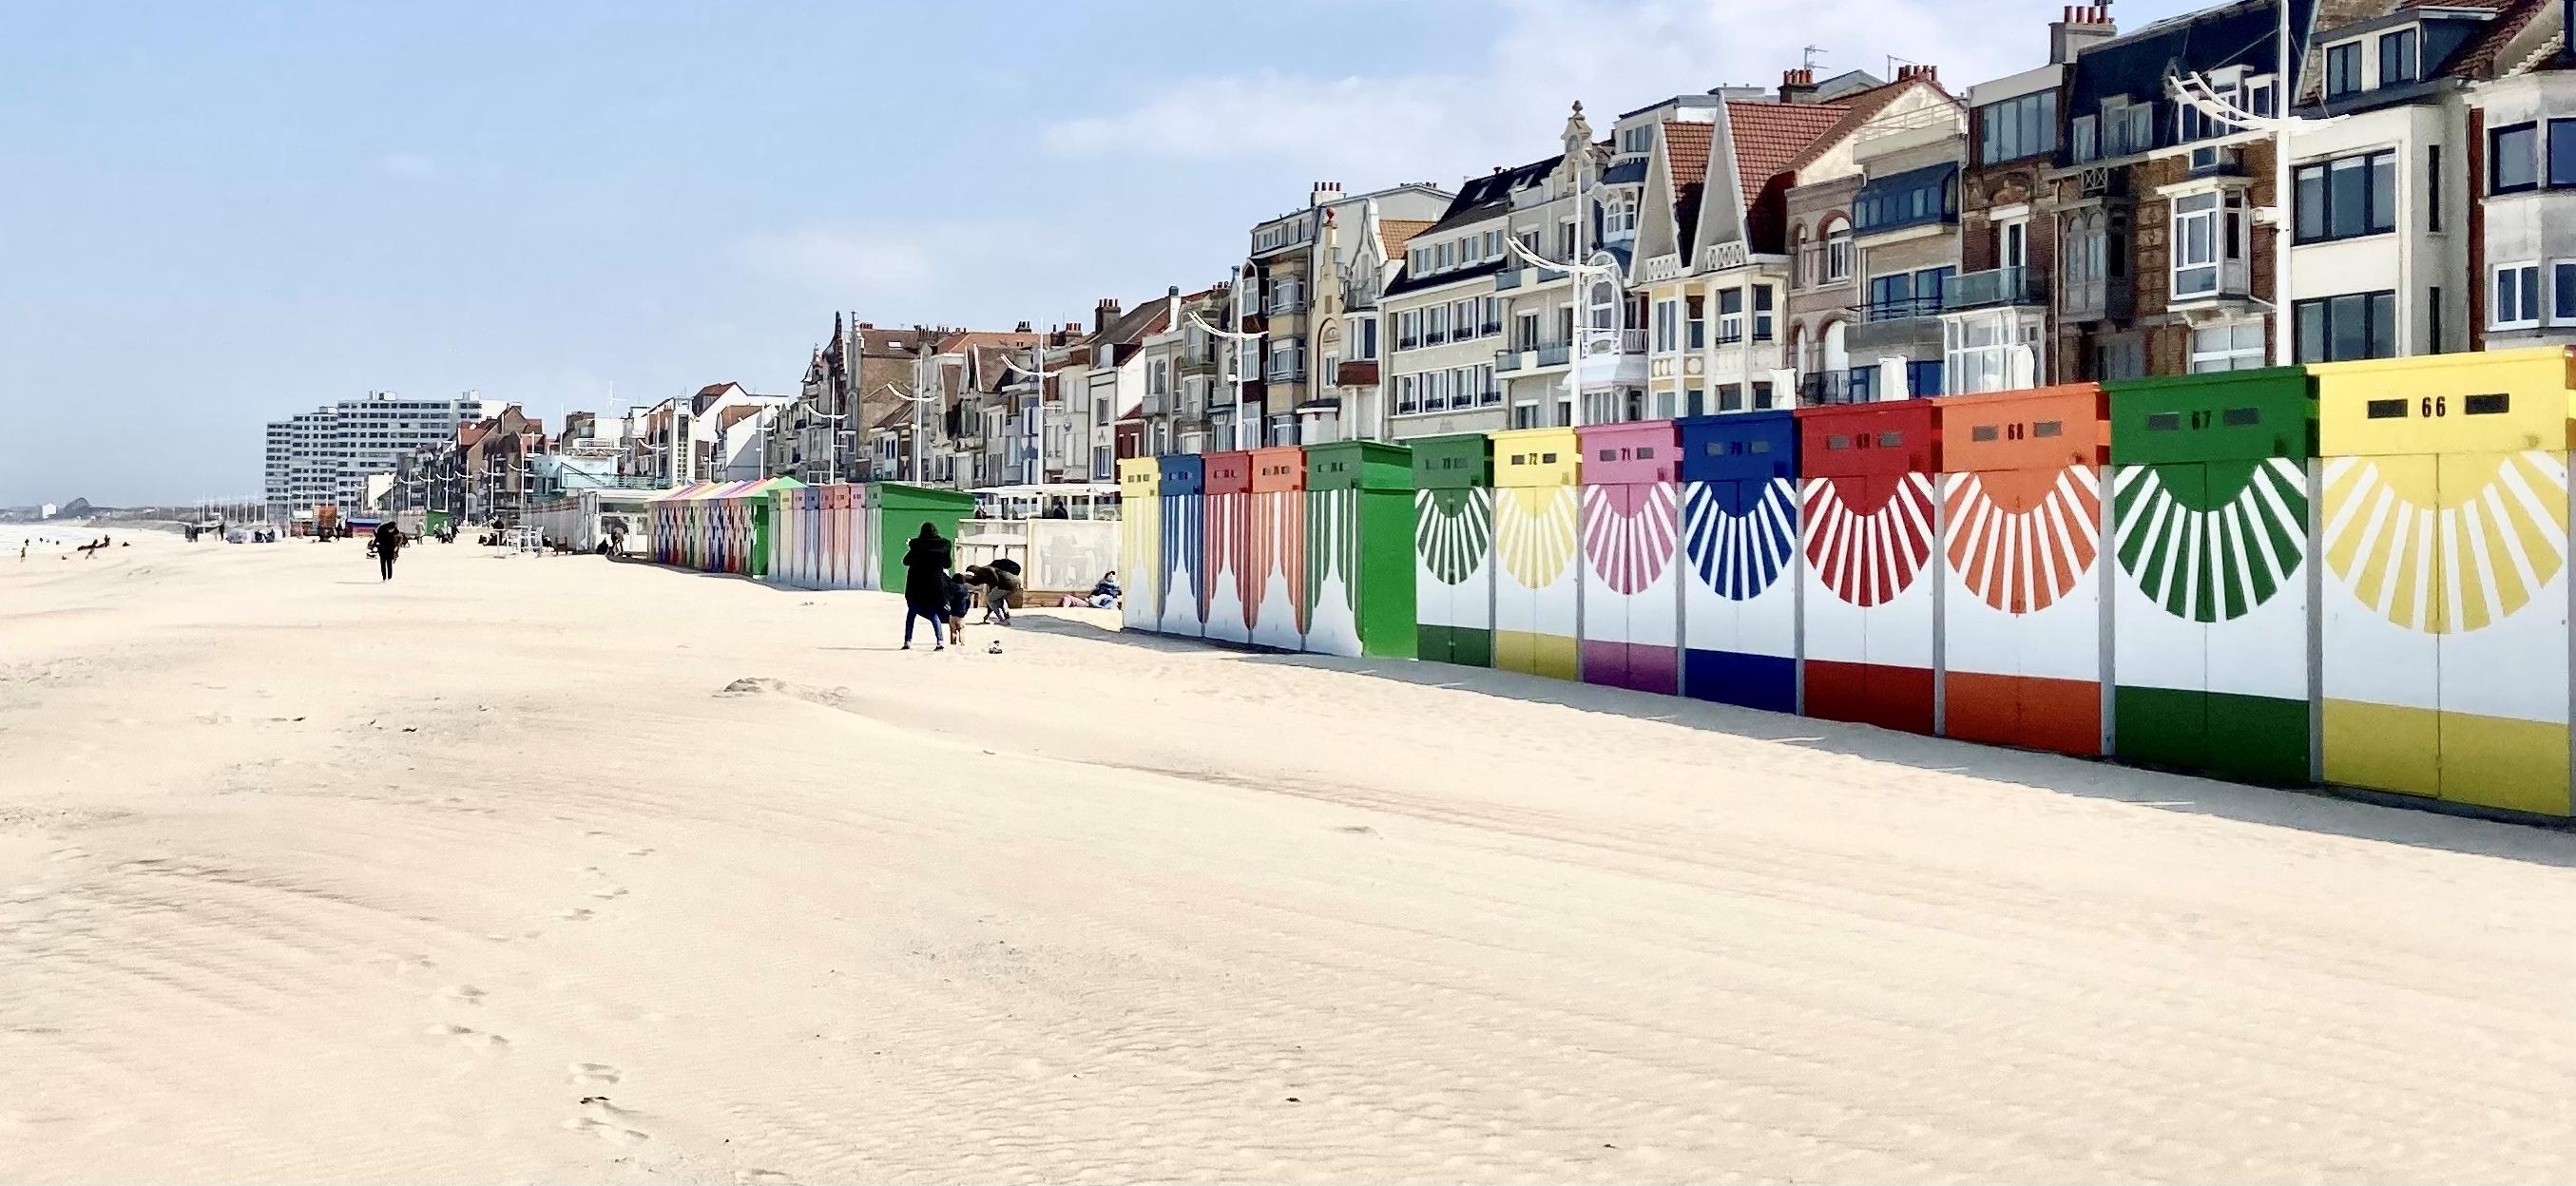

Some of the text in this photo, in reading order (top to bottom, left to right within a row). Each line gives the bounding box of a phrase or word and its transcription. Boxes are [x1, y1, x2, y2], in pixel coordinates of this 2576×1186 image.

[2422, 395, 2446, 418] 66
[2192, 410, 2211, 430] 67
[2008, 423, 2024, 440] 68
